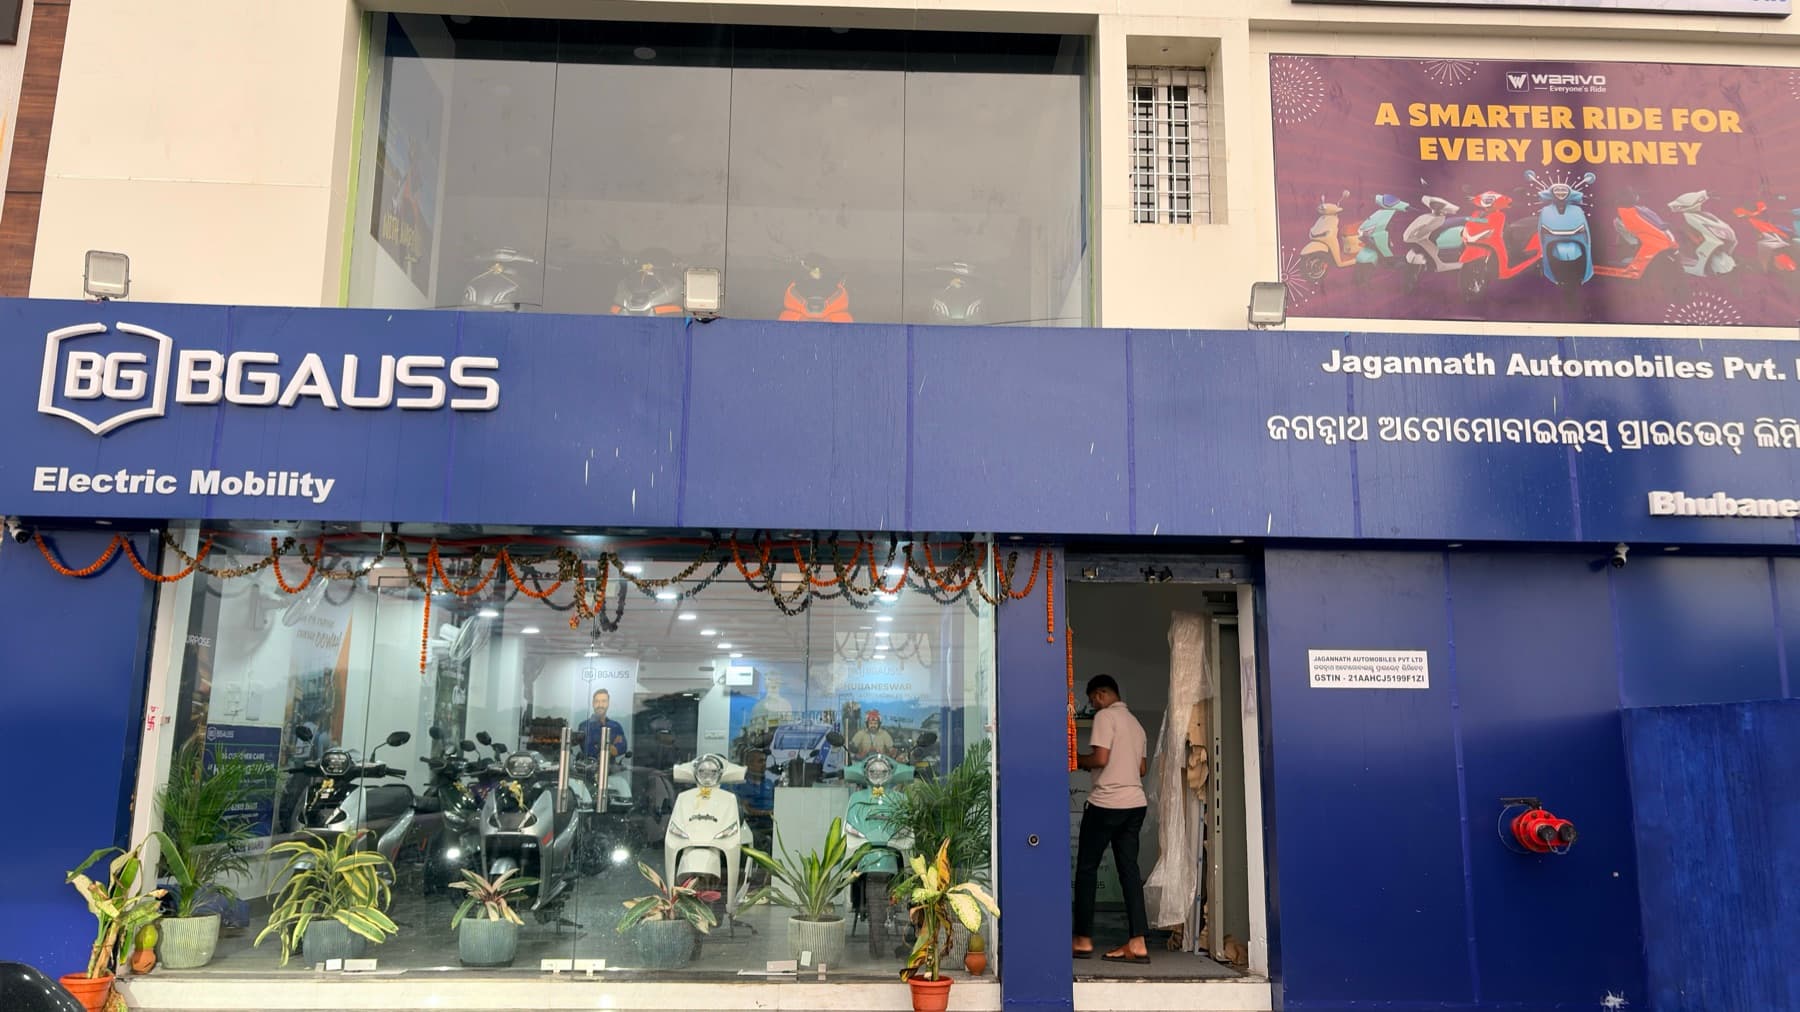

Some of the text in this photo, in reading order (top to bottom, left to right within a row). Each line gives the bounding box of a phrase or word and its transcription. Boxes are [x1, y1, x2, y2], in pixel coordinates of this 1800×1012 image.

[1549, 85, 1607, 94] Everyone's Ride
[1375, 103, 1743, 134] A SMARTER RIDE FOR
[1419, 137, 1703, 166] EVERY JOURNEY
[63, 349, 500, 412] BG BGAUSS
[1321, 349, 1496, 381] Jagannath
[1506, 352, 1714, 380] Automobiles
[1723, 356, 1787, 381] Pvt.
[1266, 414, 1369, 446] ଜଗନ୍ନାଥ
[33, 466, 336, 505] Electric Mobility
[1648, 490, 1800, 518] Bhubane
[1314, 674, 1341, 682] GSTIN
